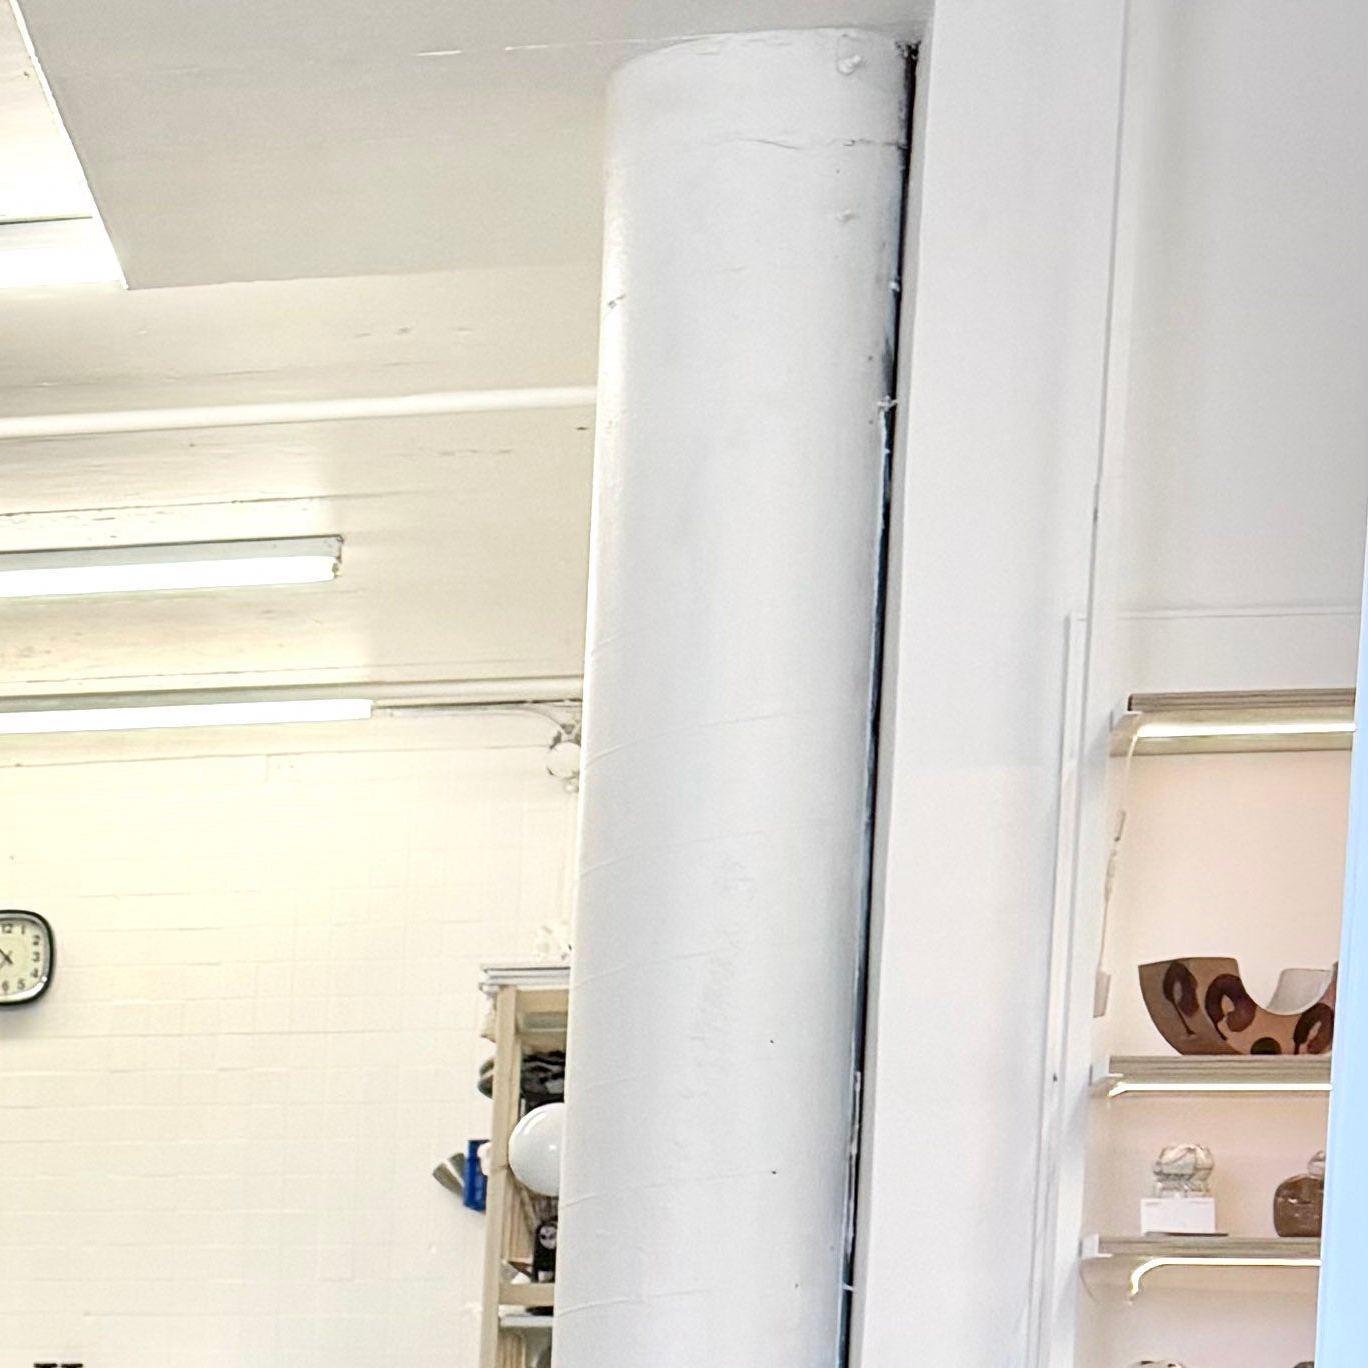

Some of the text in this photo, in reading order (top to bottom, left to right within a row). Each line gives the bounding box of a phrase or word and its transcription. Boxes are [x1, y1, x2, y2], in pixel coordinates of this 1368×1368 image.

[1, 923, 13, 934] 12
[32, 934, 40, 946] 2
[32, 951, 40, 962] 3
[17, 978, 25, 990] 5
